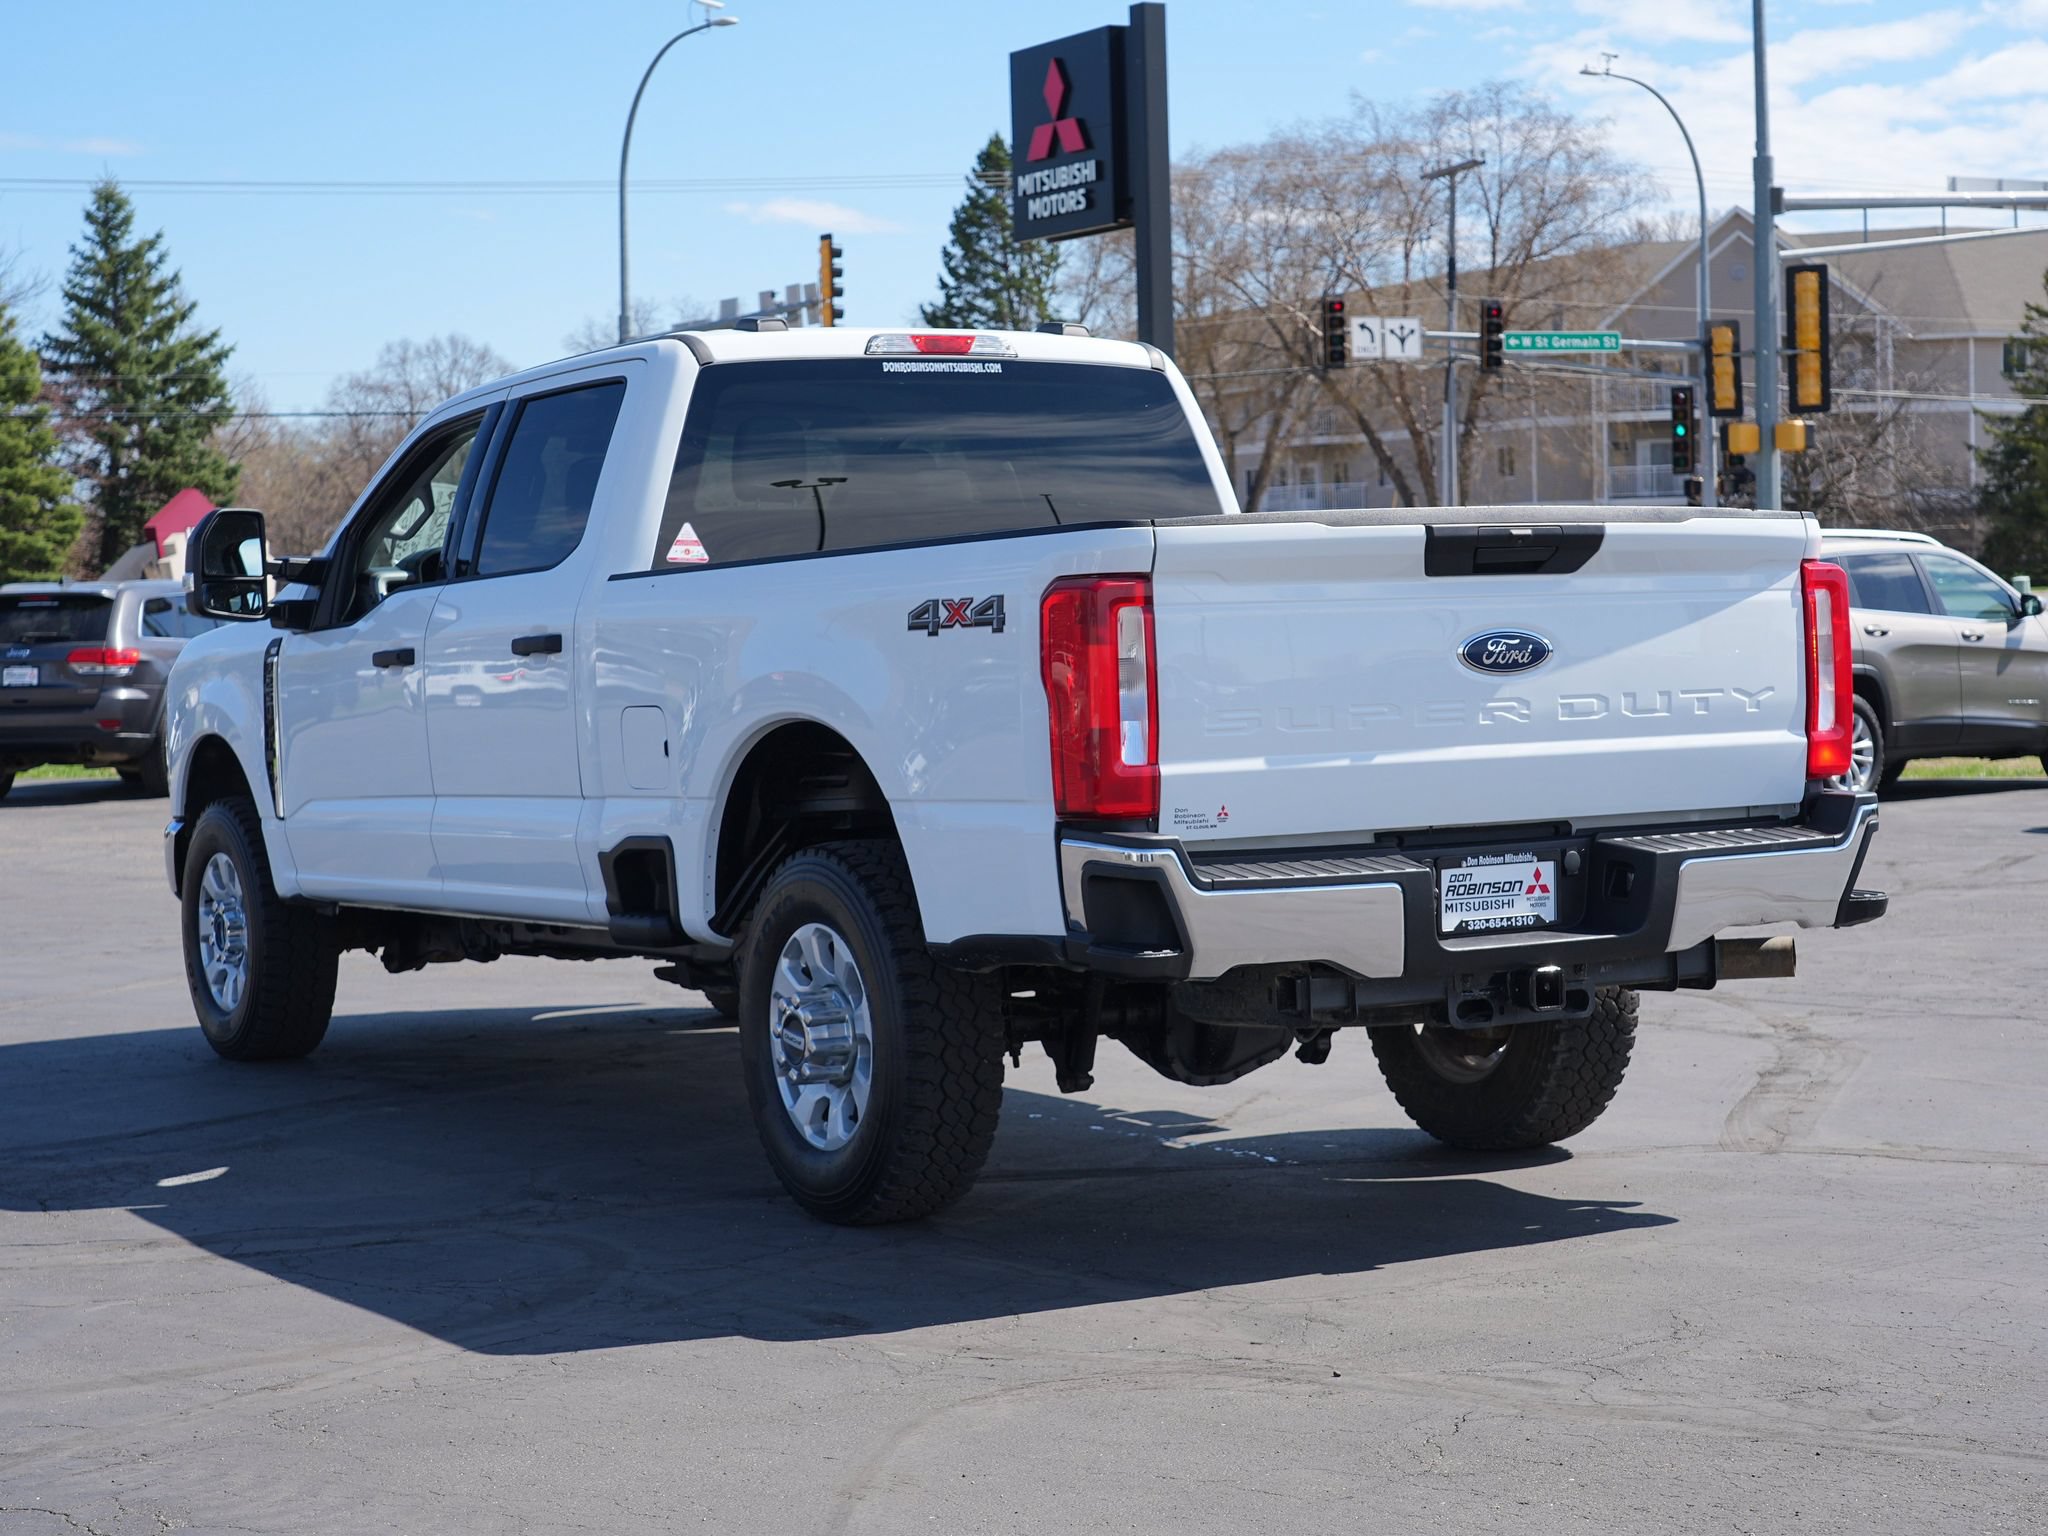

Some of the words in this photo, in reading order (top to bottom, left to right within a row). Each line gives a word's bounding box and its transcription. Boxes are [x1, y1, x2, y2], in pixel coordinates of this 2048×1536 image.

[1017, 159, 1096, 197] MITSUBISHI
[1027, 188, 1087, 220] MOTORS
[1521, 336, 1532, 347] W
[1535, 336, 1548, 347] St
[1552, 336, 1600, 348] Germain
[1603, 336, 1616, 348] St
[882, 362, 1002, 373] DONROBINSONMITSUBISHI.COM
[1482, 638, 1533, 665] Ford
[1203, 696, 1531, 736] SUPER
[1558, 686, 1775, 721] DUTY
[1467, 856, 1478, 867] Don
[1479, 854, 1504, 866] Robinson
[1505, 851, 1533, 864] Mitsubishi
[1449, 873, 1472, 883] DON
[1445, 880, 1523, 897] ROBINSON
[1445, 899, 1514, 914] MITSUBISHI
[1467, 916, 1534, 931] 320-654-1310
